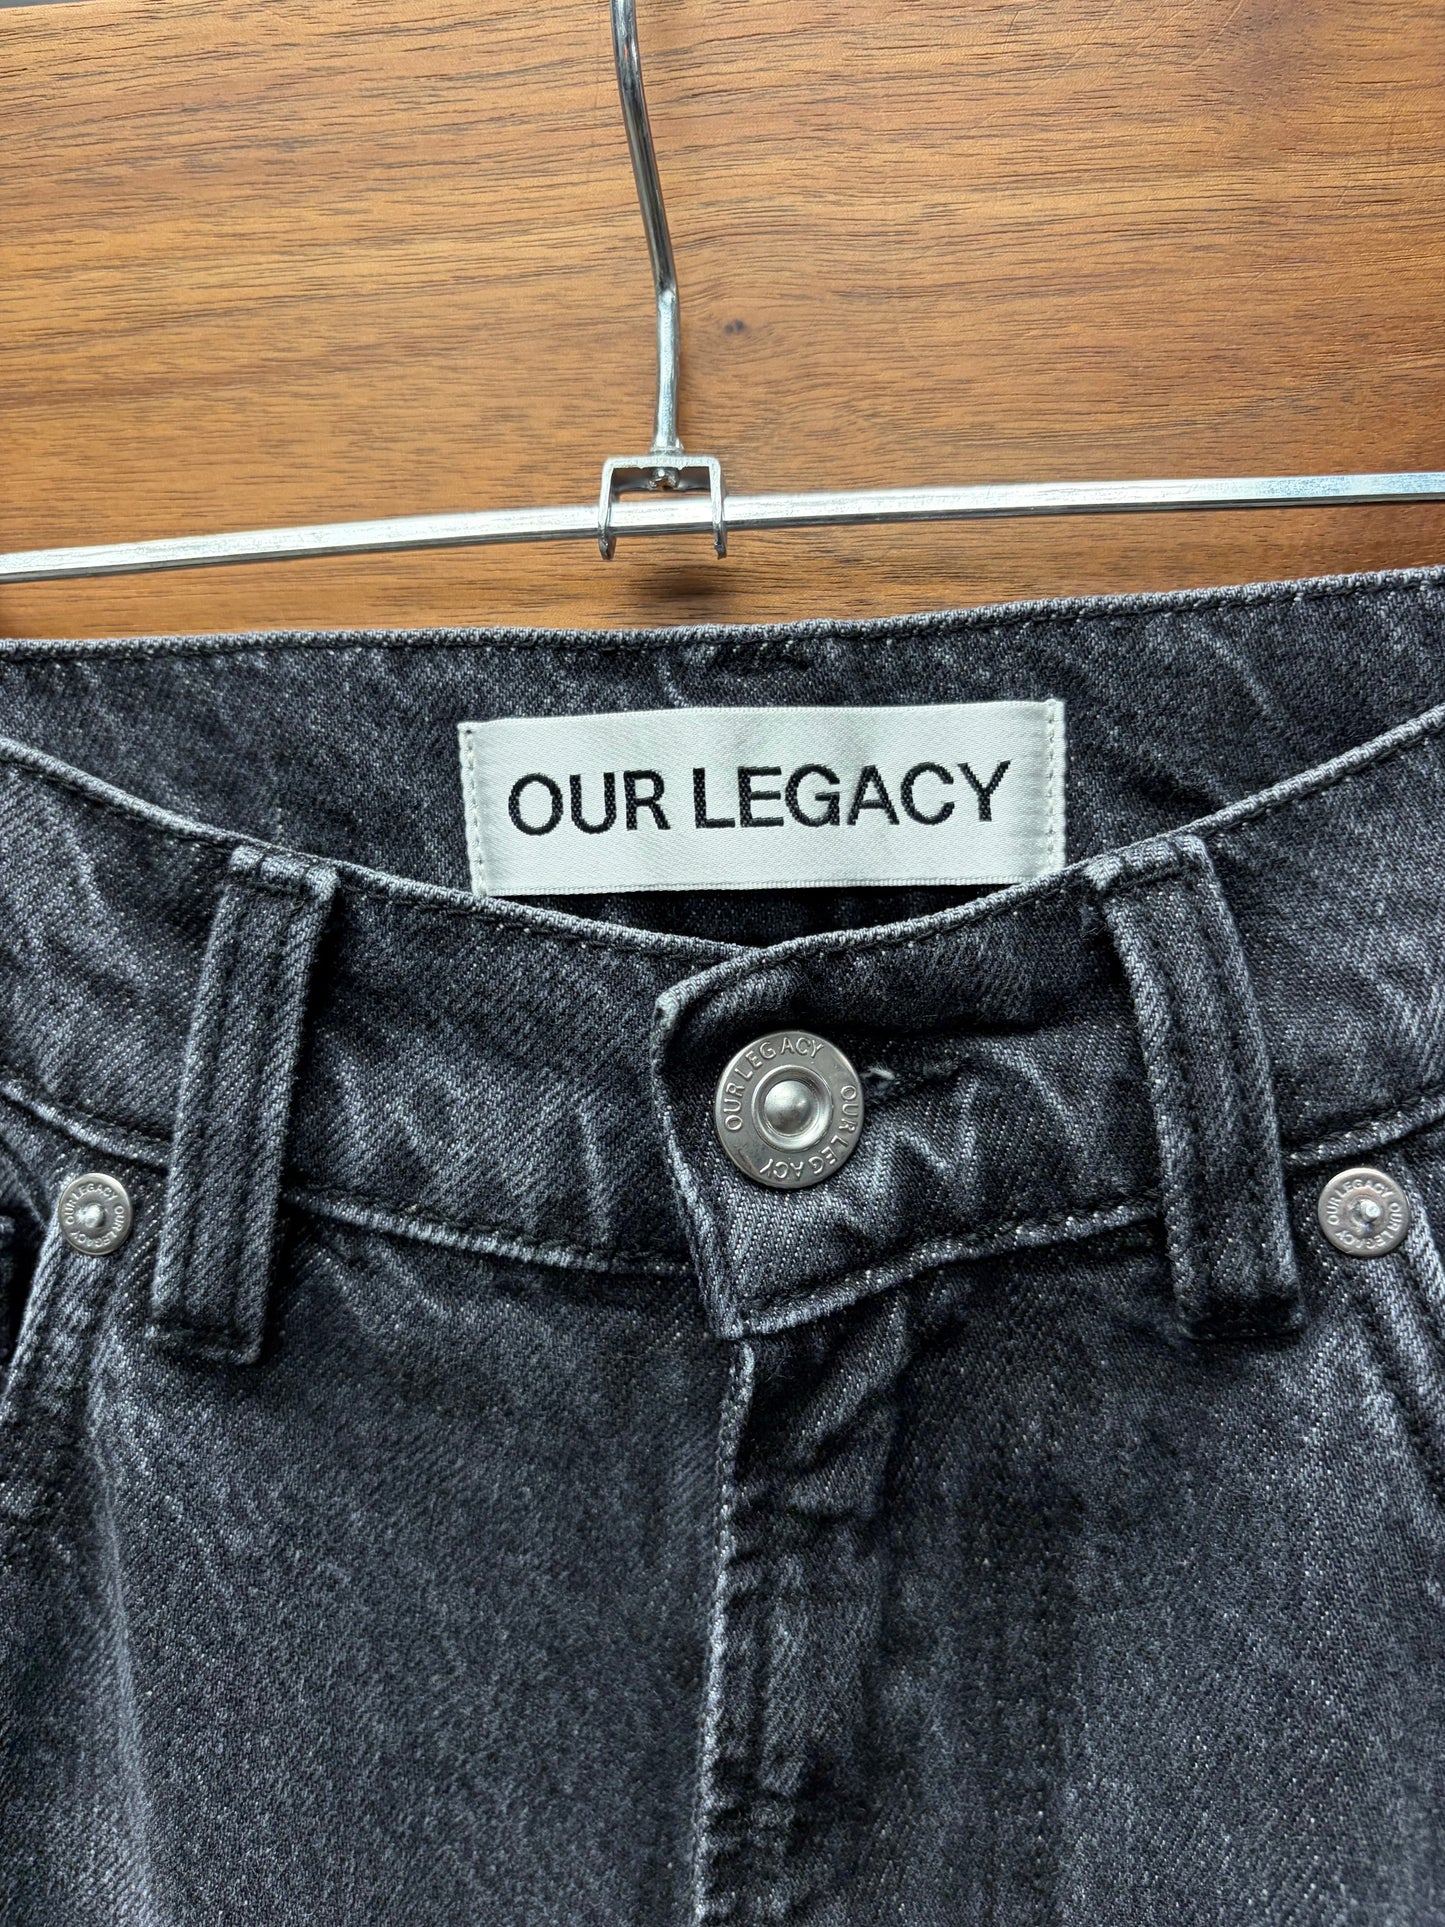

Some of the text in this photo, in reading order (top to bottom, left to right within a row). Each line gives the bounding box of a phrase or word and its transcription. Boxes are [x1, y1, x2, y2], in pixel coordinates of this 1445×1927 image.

[508, 759, 1012, 835] OUR LEGACY
[723, 1036, 824, 1131] OUR LEGACY
[759, 1085, 860, 1180] OUR LEGACY
[64, 1183, 118, 1225] OUR LEGACY
[112, 1205, 125, 1231] OUR
[1326, 1179, 1395, 1225] OUR LEGACY
[1387, 1202, 1403, 1231] OUR
